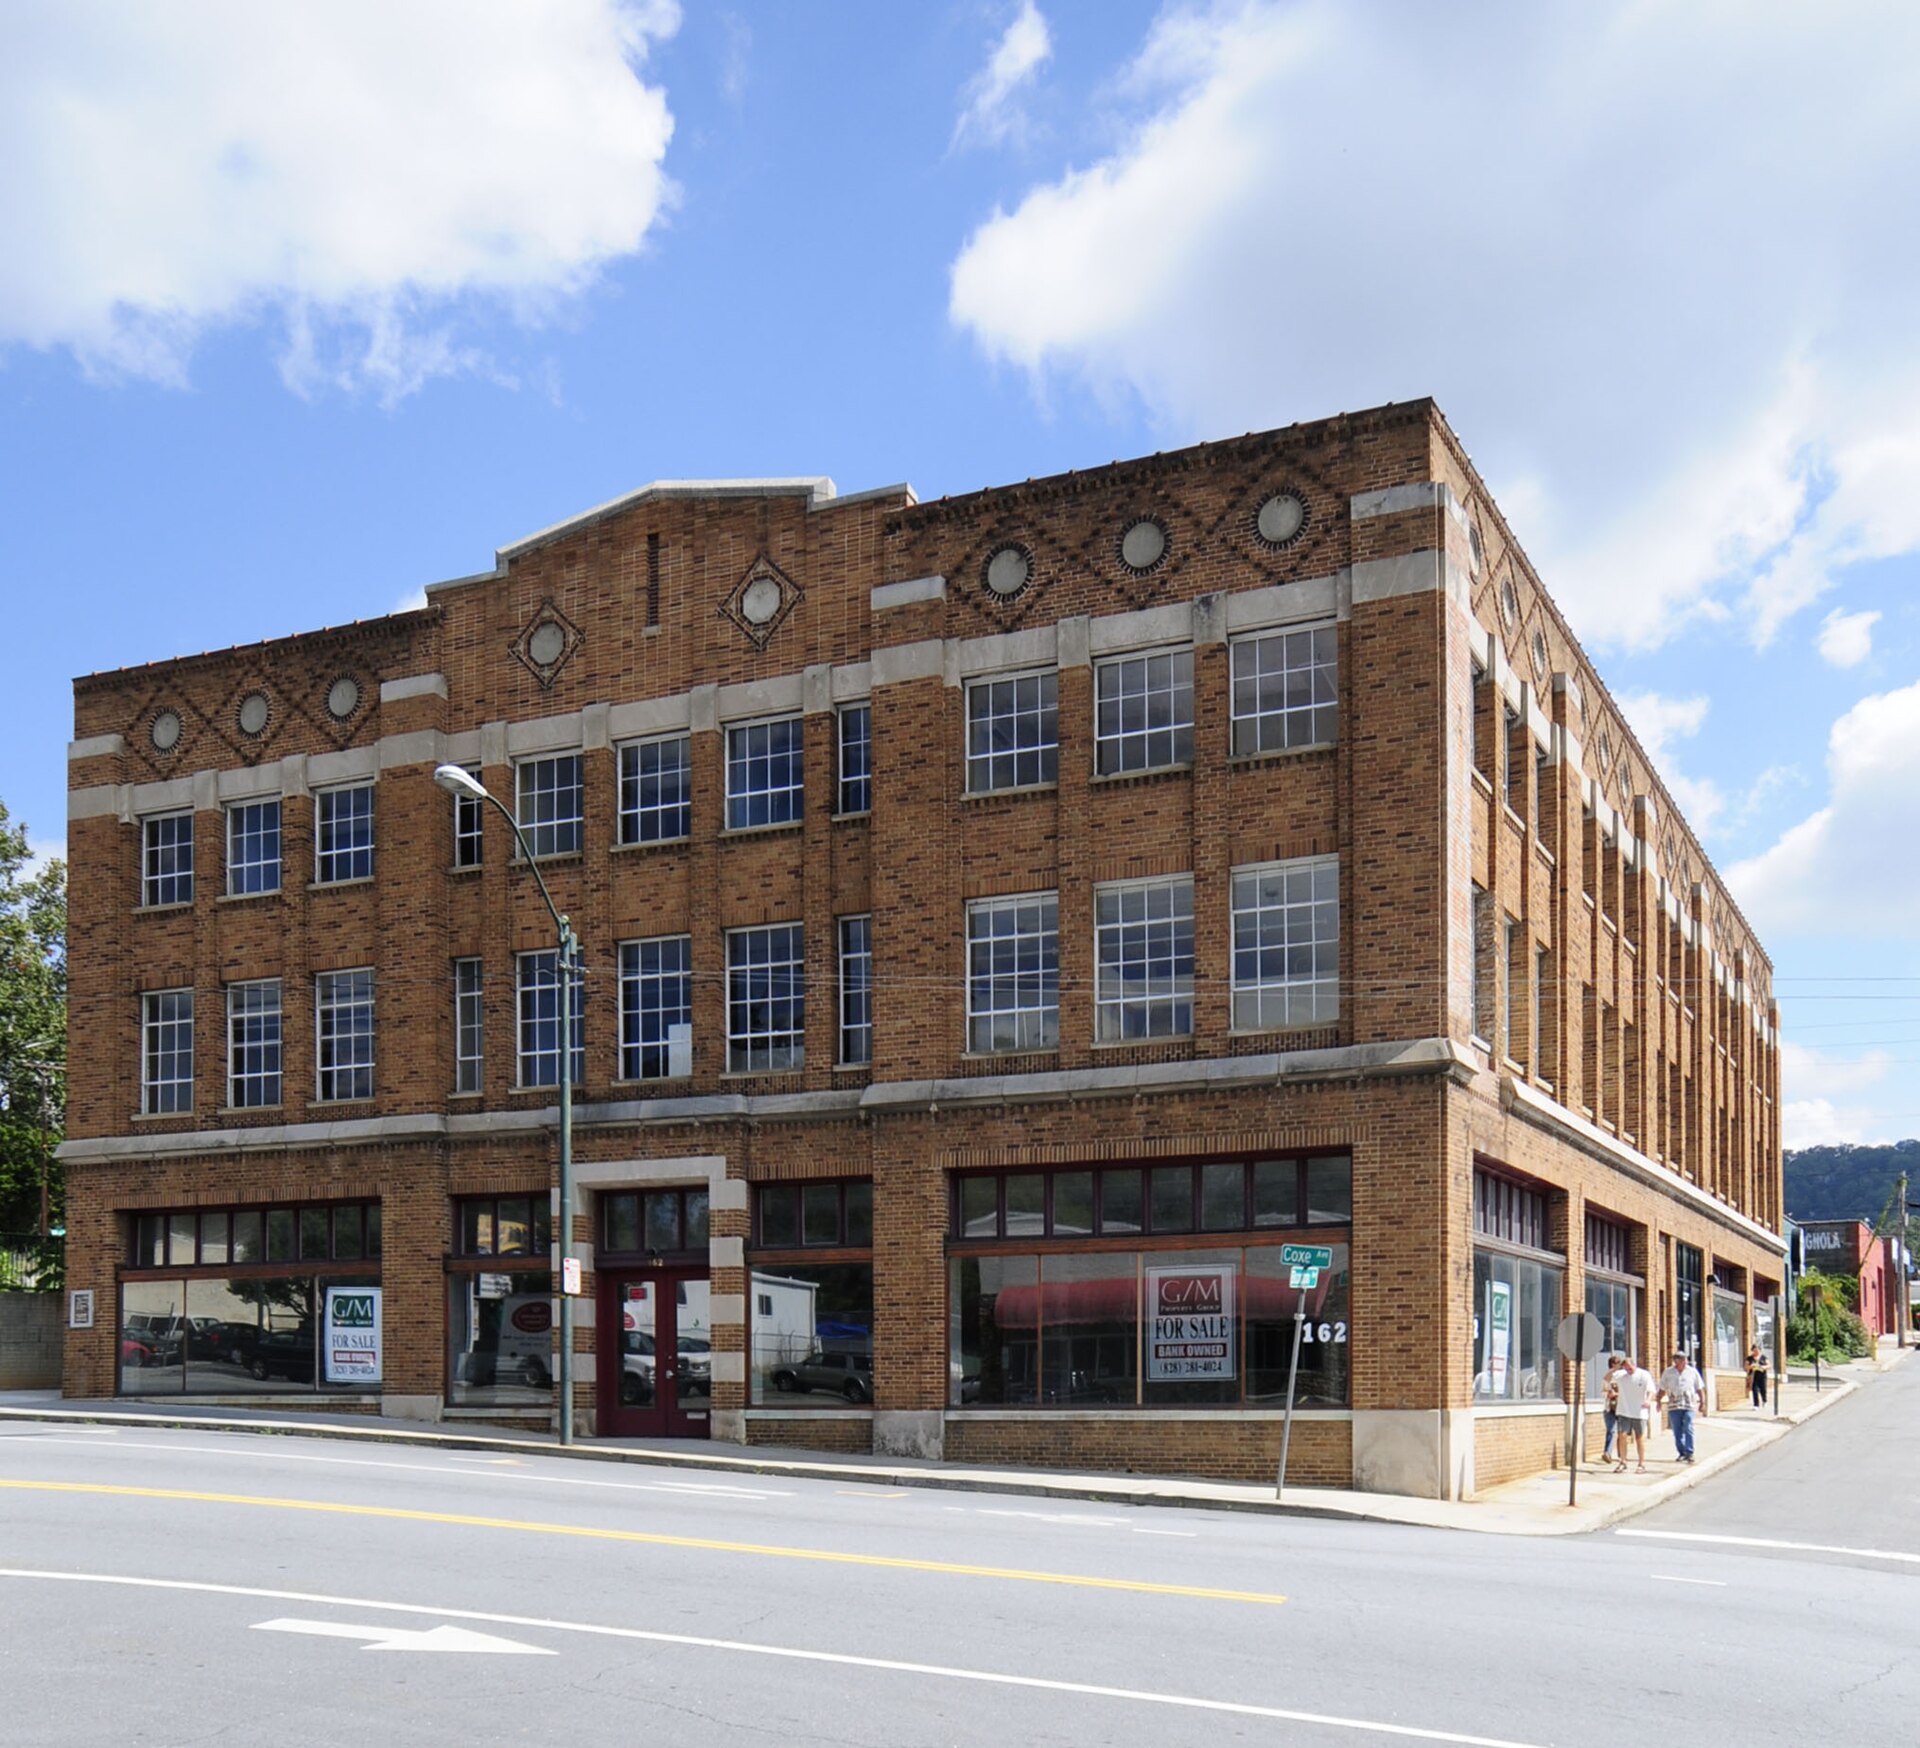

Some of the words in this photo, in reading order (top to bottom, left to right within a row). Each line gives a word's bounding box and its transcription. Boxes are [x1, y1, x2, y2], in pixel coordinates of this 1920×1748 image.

[1284, 1247, 1312, 1263] Coxe
[1155, 1317, 1184, 1339] FOR
[1190, 1316, 1229, 1339] SALE
[1302, 1321, 1347, 1343] 162
[333, 1334, 349, 1348] FOR
[351, 1335, 376, 1348] SALE
[1158, 1344, 1186, 1357] BANK
[1187, 1344, 1224, 1356] OWNED
